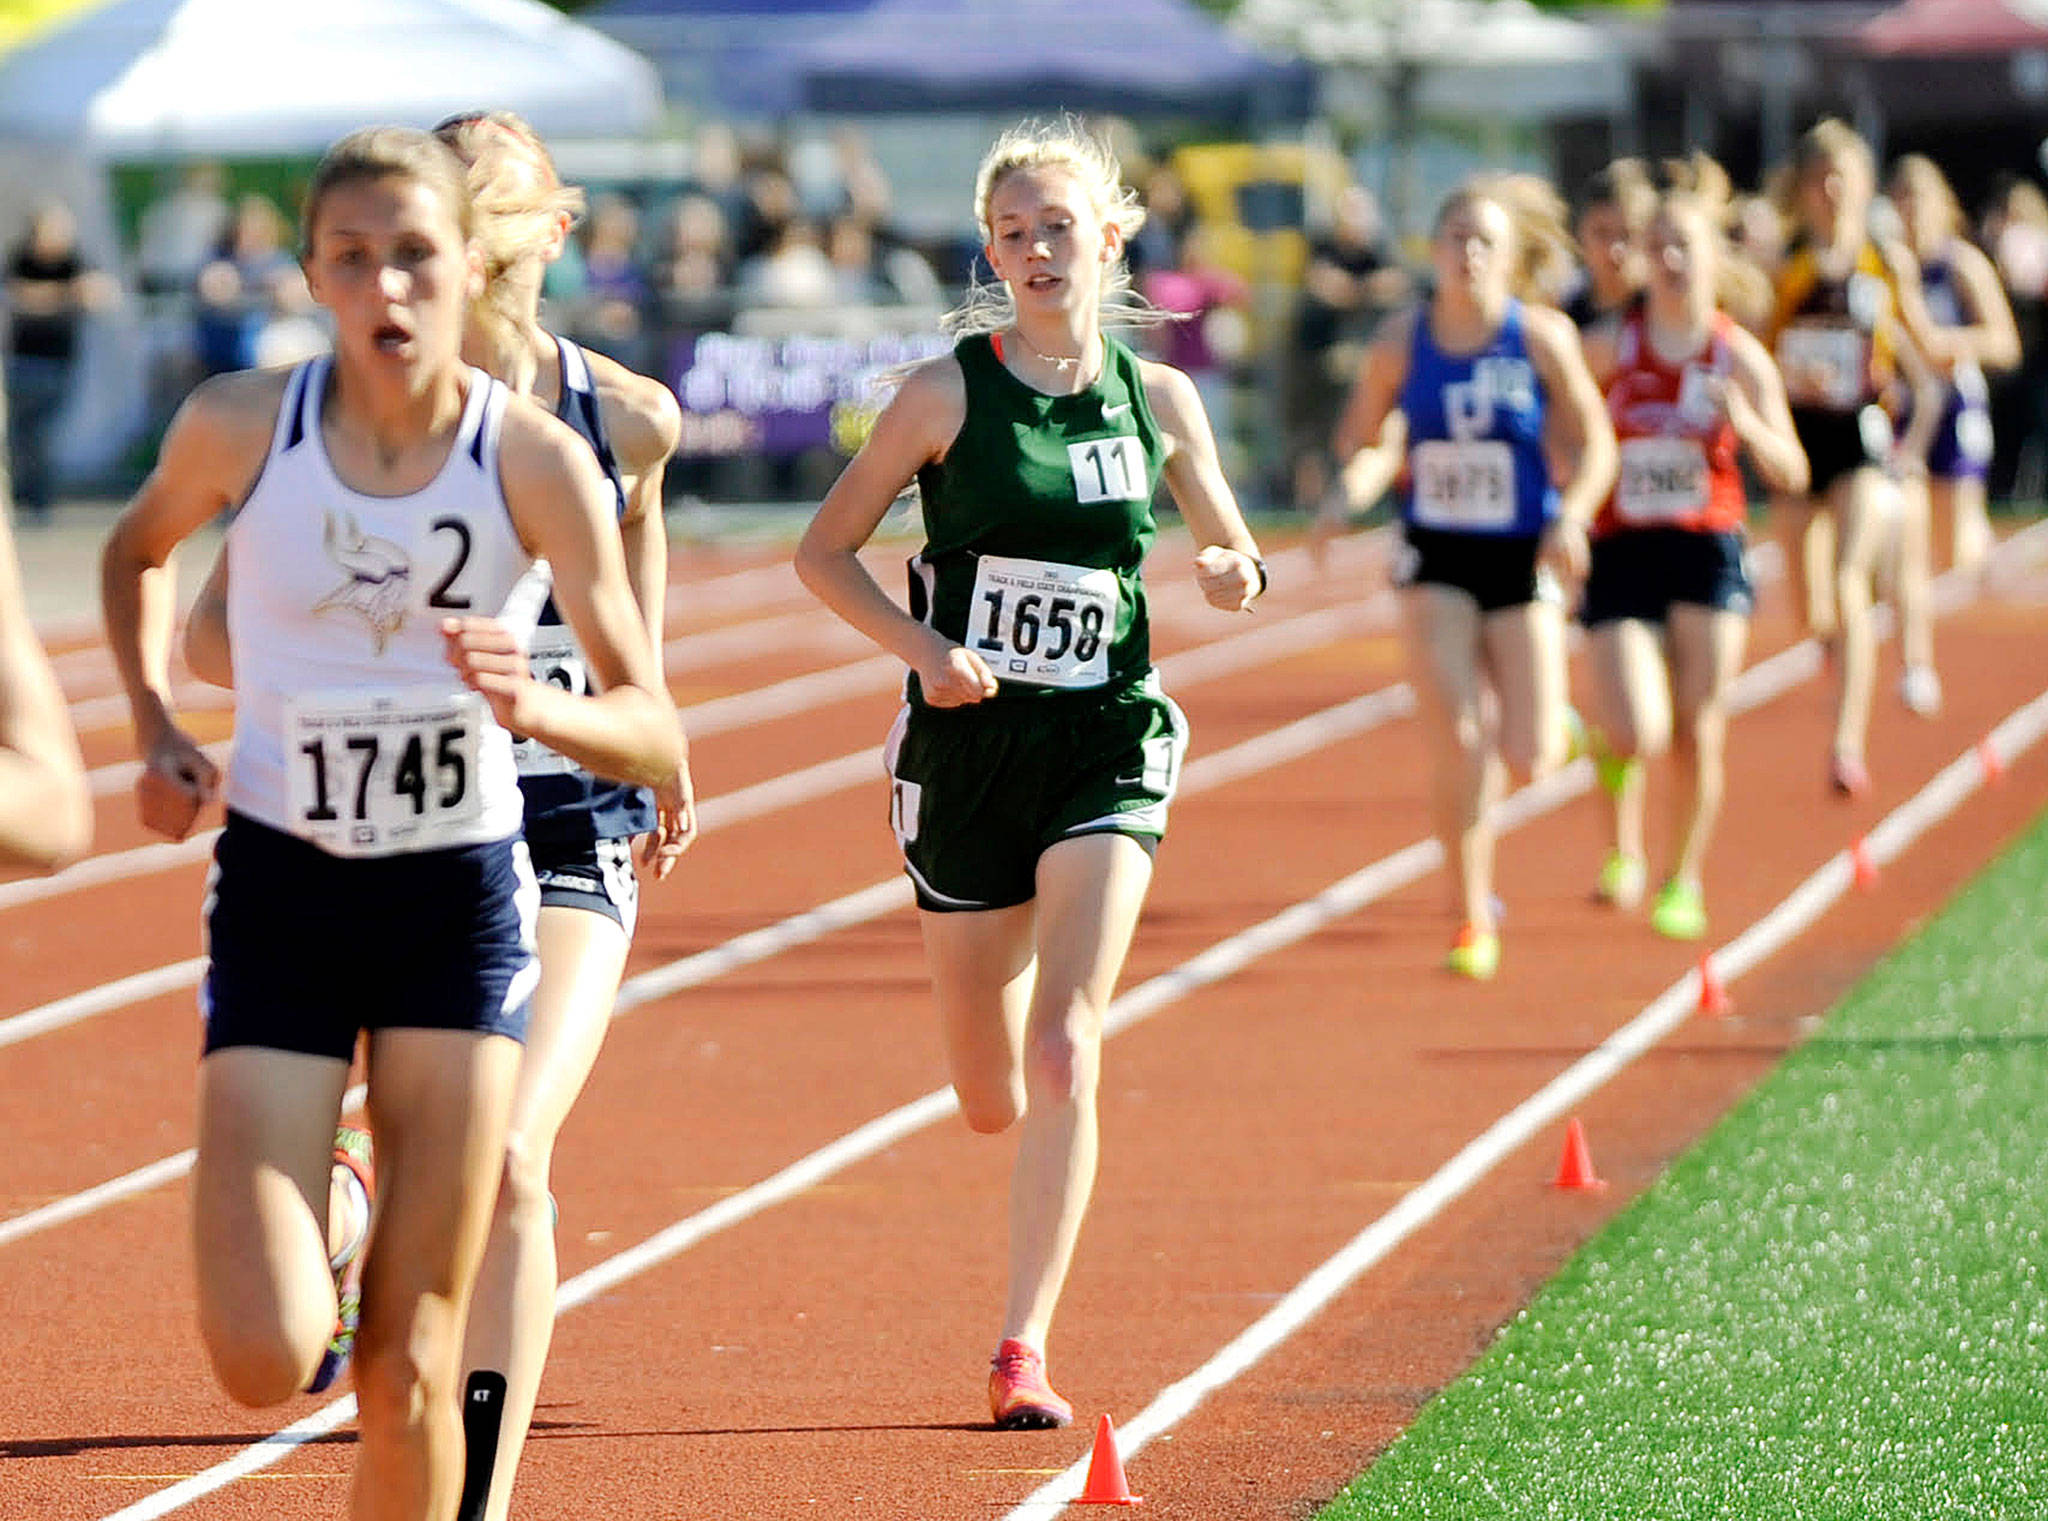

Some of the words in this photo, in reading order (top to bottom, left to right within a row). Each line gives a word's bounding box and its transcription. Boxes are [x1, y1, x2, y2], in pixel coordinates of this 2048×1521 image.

[1085, 441, 1132, 495] 11
[430, 517, 471, 609] 2
[977, 588, 1104, 662] 1658
[302, 730, 466, 821] 1745
